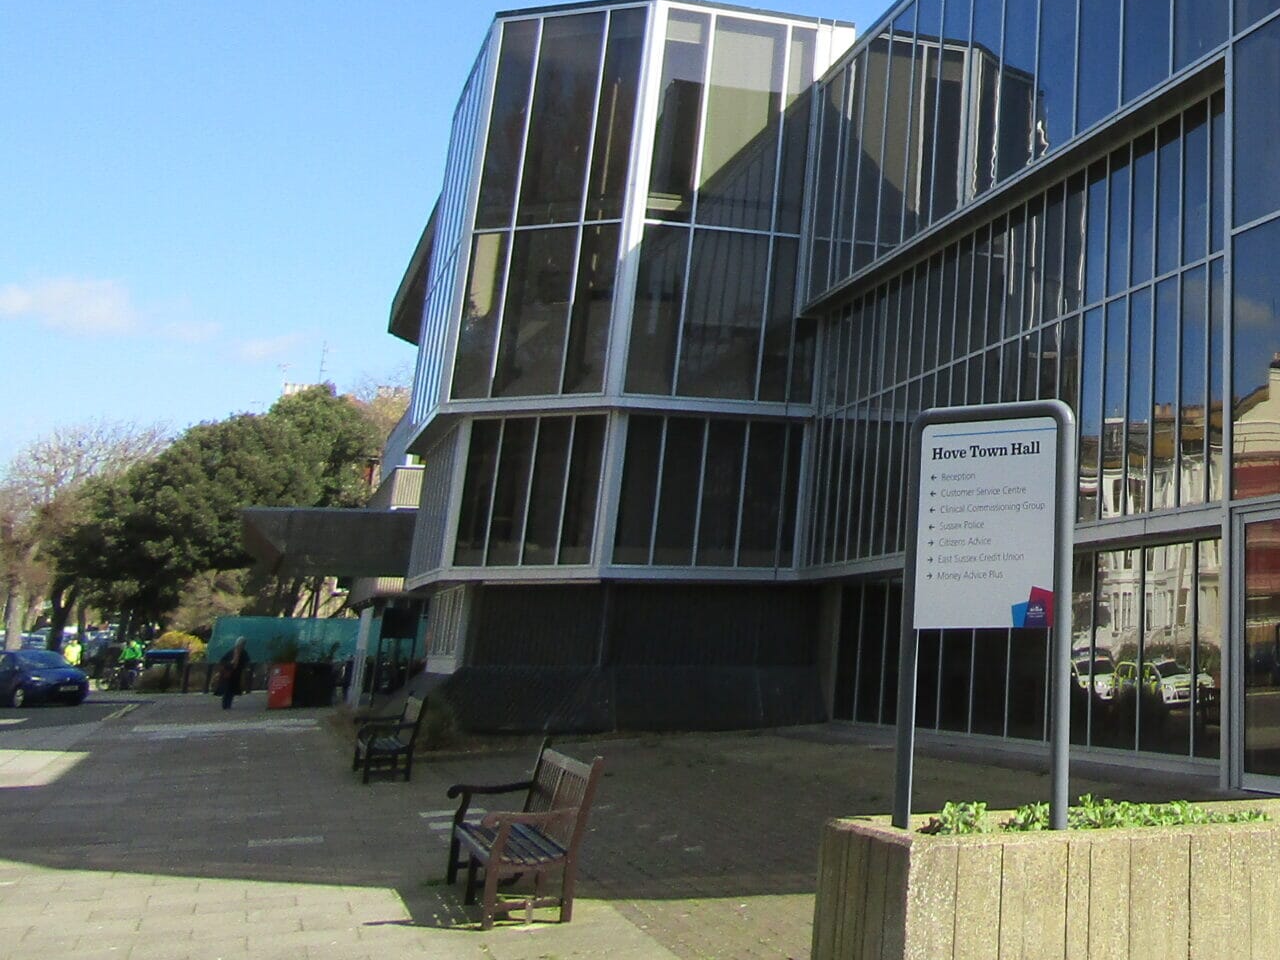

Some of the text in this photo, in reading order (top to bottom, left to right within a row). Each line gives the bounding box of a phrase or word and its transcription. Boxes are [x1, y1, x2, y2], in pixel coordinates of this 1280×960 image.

[932, 441, 1040, 460] Hove Town Hall
[941, 472, 976, 481] Reception
[941, 485, 1027, 497] Customer Service Centre
[940, 501, 1046, 514] Clinical Commissioning Group
[940, 520, 985, 530] Sussex Police
[939, 537, 992, 547] Citizens Advice
[937, 552, 1025, 564] East Sussex Credit Union
[937, 570, 1004, 581] Money Advice Plus
